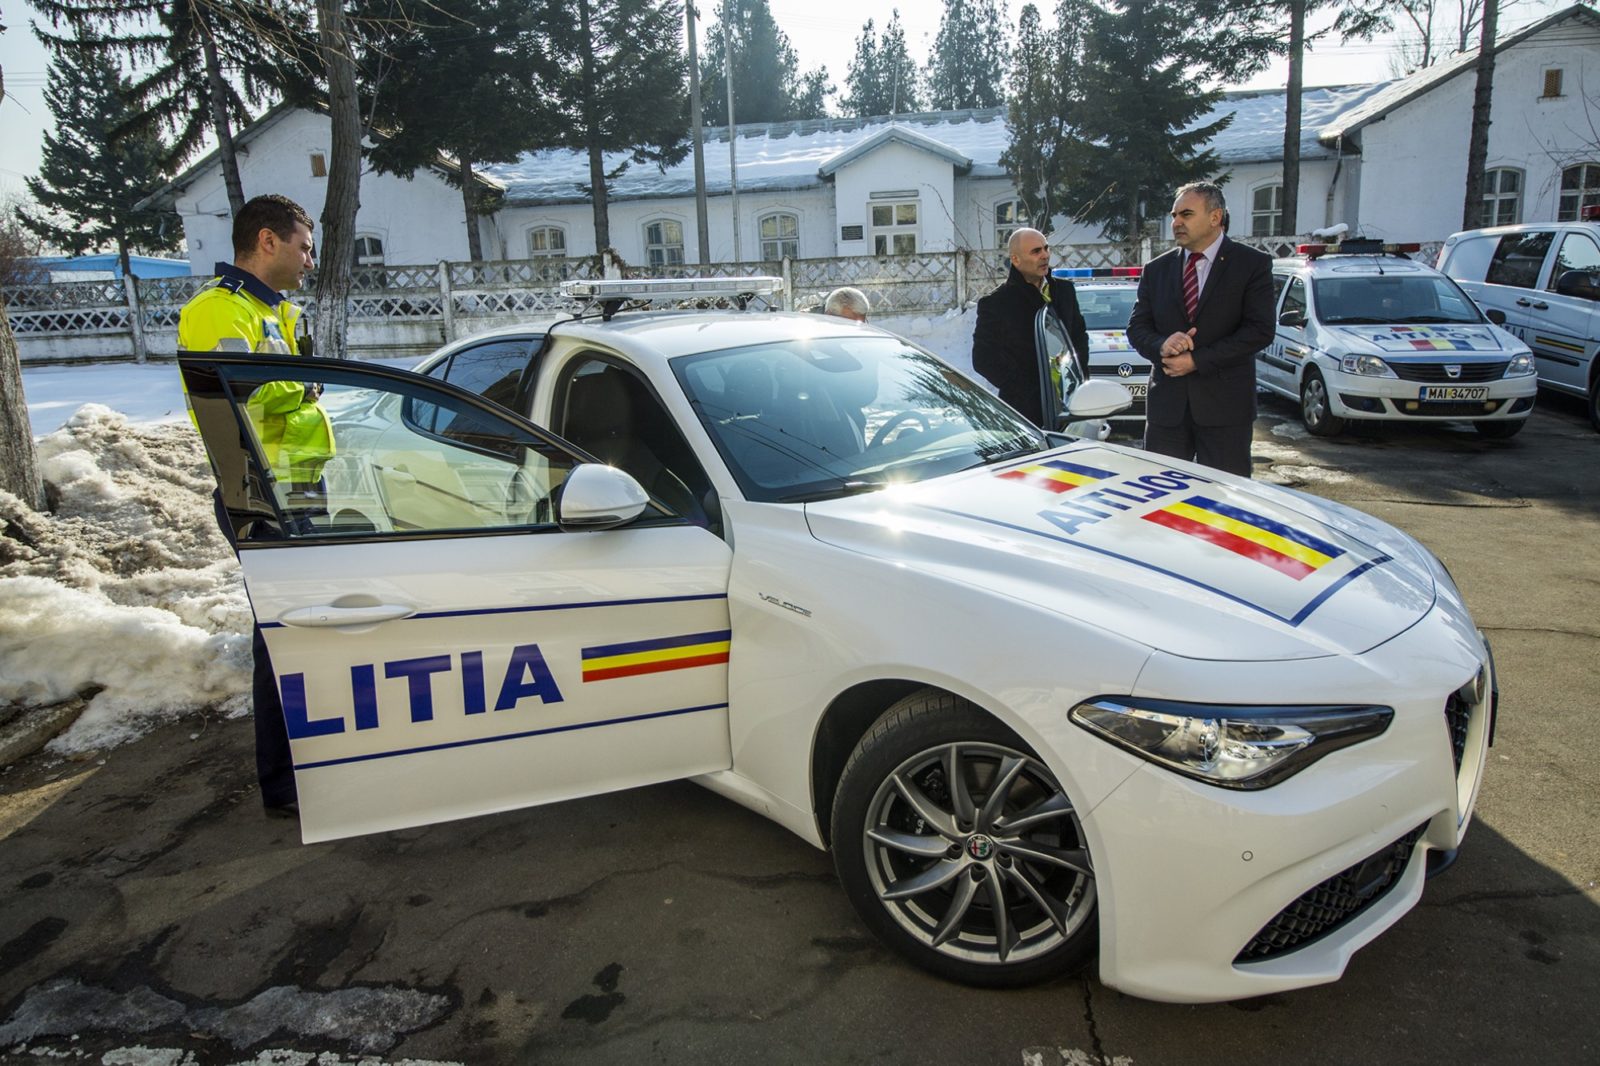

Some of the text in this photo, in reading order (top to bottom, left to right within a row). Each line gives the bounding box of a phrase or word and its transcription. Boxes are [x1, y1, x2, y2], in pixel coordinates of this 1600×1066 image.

[1428, 388, 1485, 399] MAI 34707
[279, 643, 565, 740] LITIA
